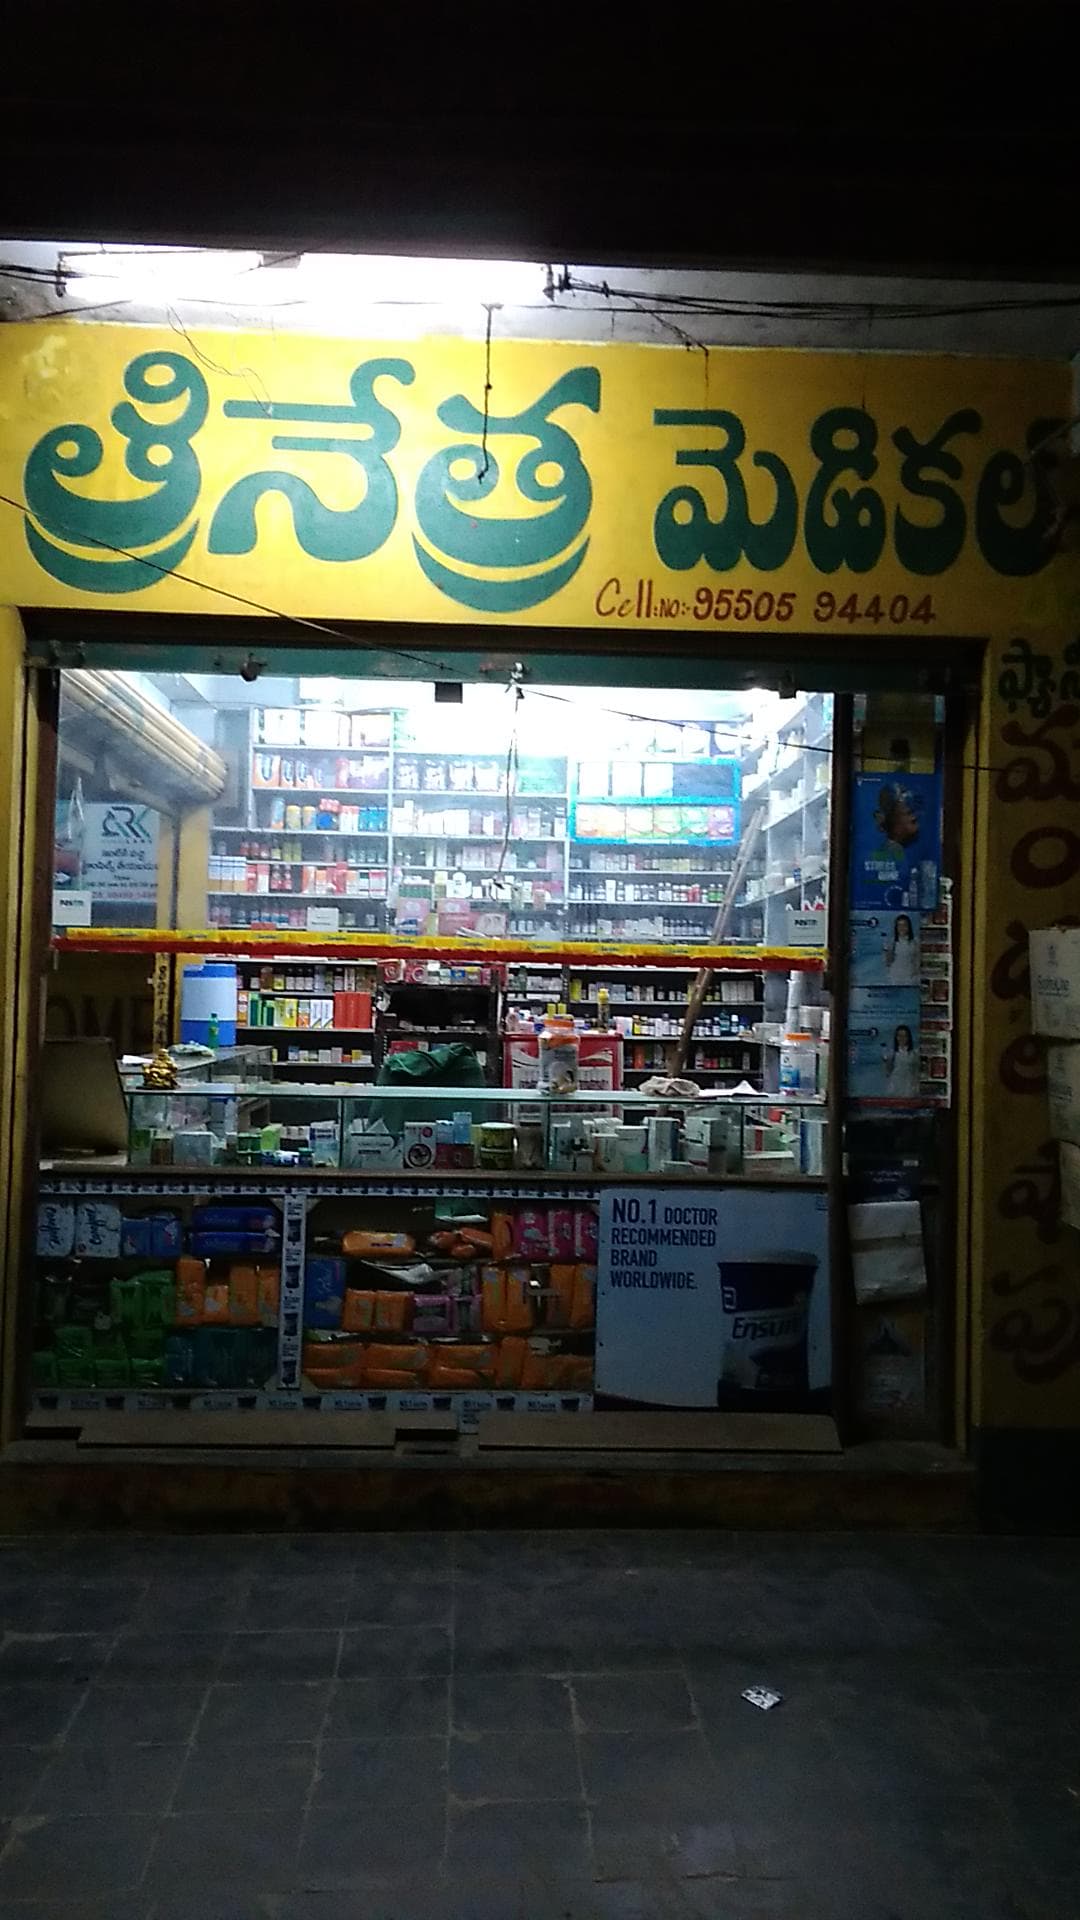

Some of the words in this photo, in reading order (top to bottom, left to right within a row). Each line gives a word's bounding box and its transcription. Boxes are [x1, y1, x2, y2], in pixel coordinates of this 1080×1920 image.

[22, 350, 601, 613] త్రినేత్ర
[814, 591, 935, 624] 94404
[612, 1198, 657, 1224] NO.1
[664, 1207, 718, 1226] DOCTOR
[611, 1227, 716, 1247] RECOMMENDED
[610, 1249, 658, 1268] BRAND
[609, 1270, 698, 1290] WORLDWIDE.
